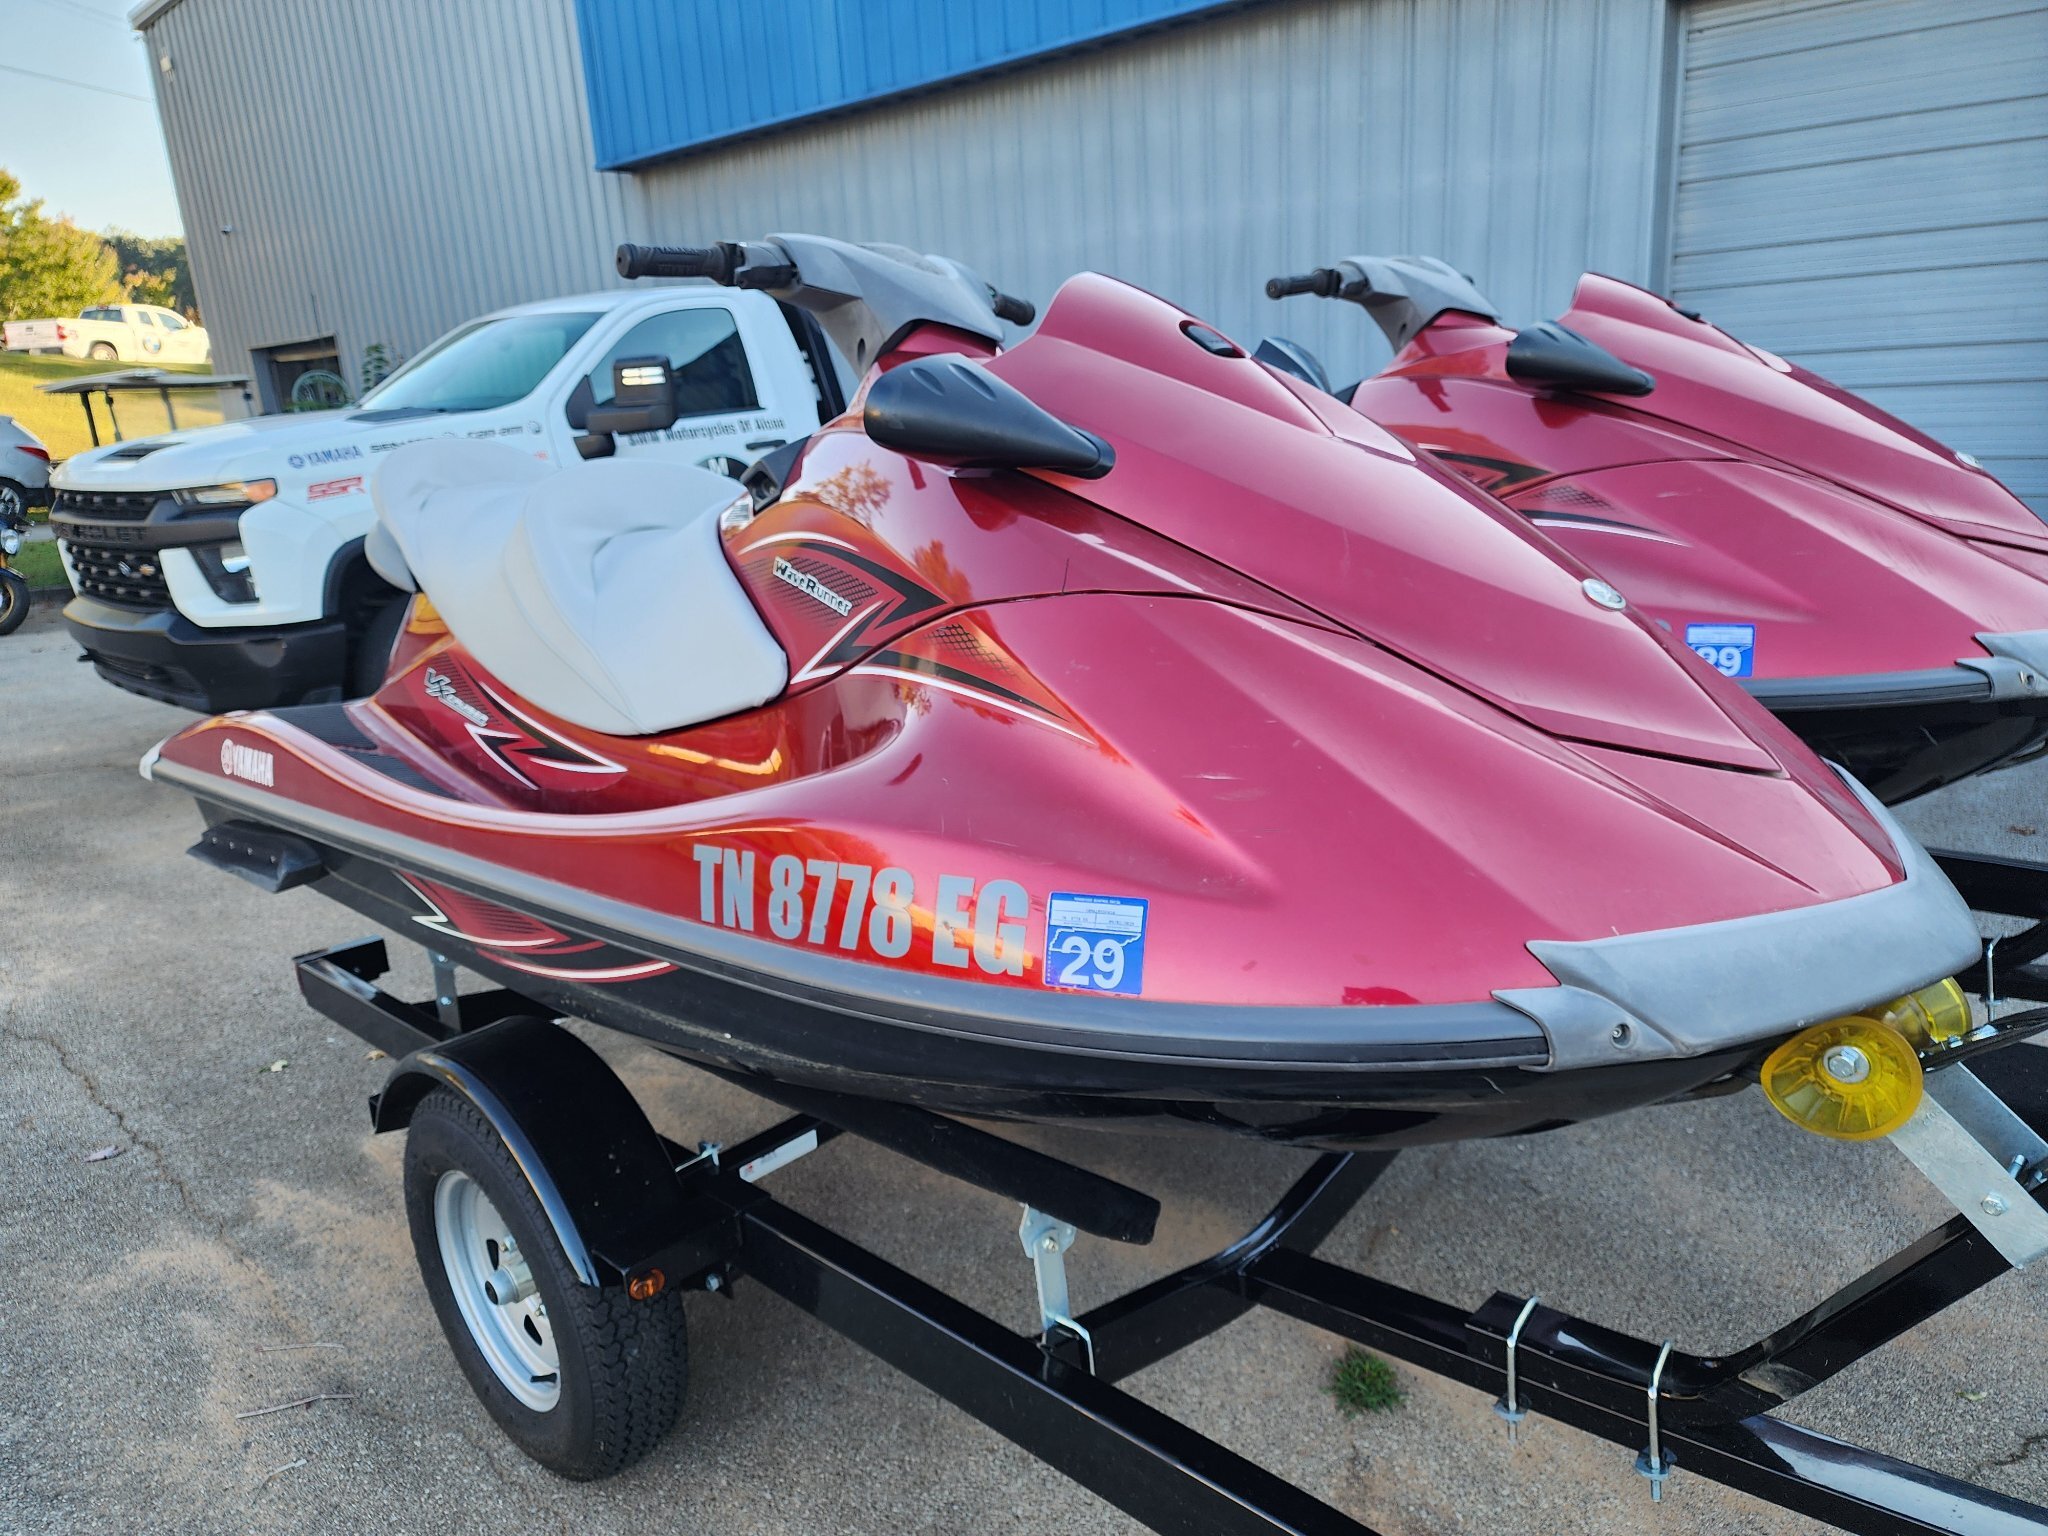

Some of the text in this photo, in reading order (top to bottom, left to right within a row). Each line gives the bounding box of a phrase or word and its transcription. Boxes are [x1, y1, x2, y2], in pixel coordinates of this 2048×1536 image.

[666, 421, 736, 441] Motorcycles
[304, 445, 364, 466] YAMAHA
[773, 556, 853, 616] WaveRunner
[233, 744, 274, 787] YAMAHA
[693, 844, 1028, 976] TN 8778 EG
[1059, 936, 1124, 989] 29
